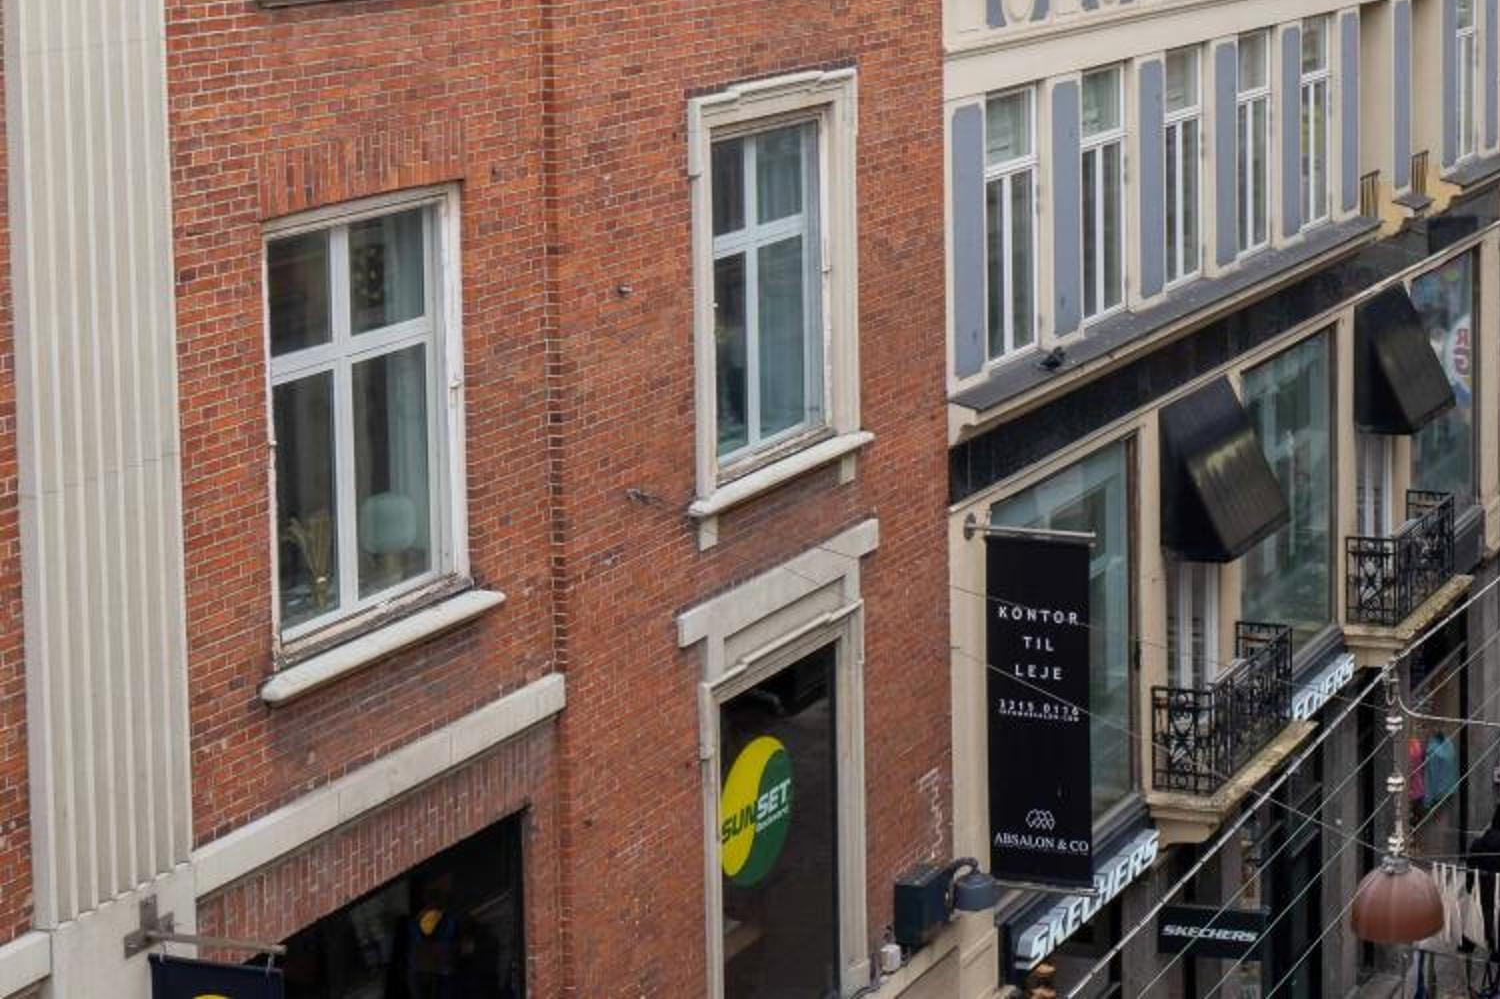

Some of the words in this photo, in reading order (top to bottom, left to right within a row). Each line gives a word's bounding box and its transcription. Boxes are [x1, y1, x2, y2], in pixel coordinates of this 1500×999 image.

[999, 606, 1079, 625] KONTOR
[1023, 635, 1054, 652] TIL
[1015, 663, 1062, 681] LEJE
[721, 777, 791, 846] SUNSET
[993, 832, 1055, 849] ABSALON
[1057, 839, 1068, 851] &
[1069, 840, 1090, 852] CO
[1161, 923, 1259, 942] SKECHERS
